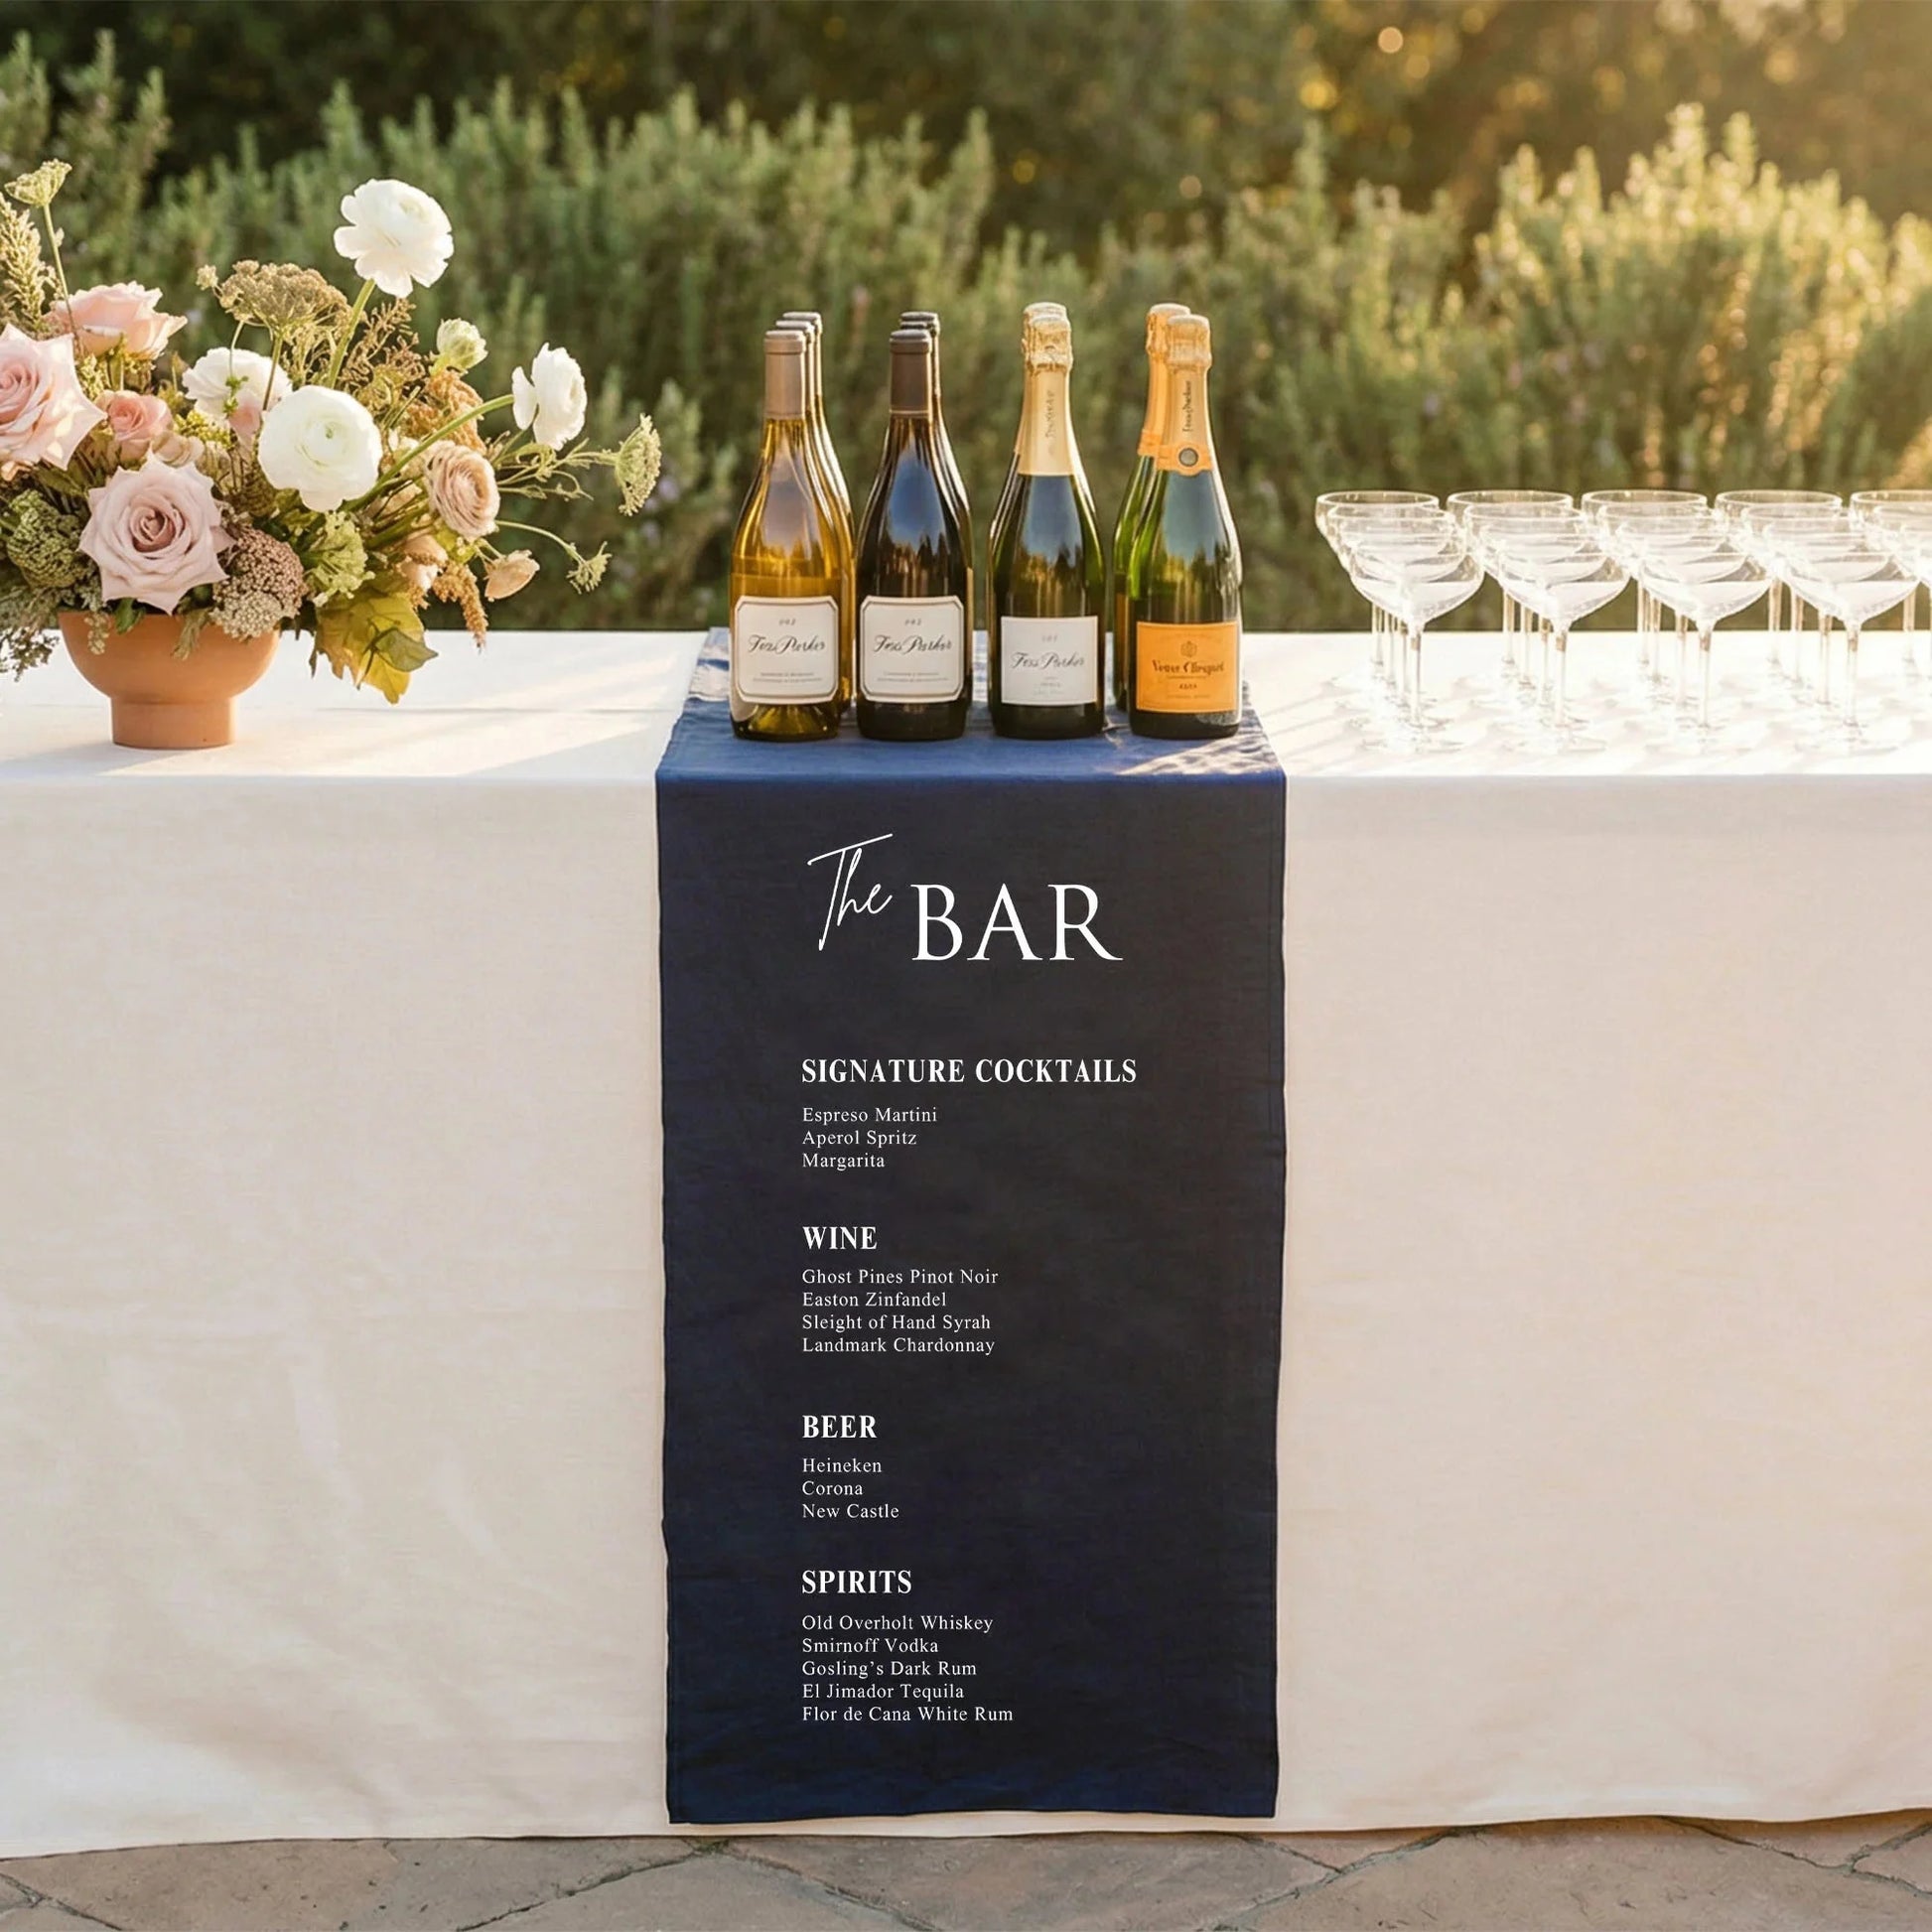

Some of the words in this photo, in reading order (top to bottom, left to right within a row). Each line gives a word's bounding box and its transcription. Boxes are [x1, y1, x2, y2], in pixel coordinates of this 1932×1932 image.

[807, 833, 893, 951] The
[910, 884, 1123, 960] BAR
[801, 1058, 965, 1083] SIGNATURE
[975, 1058, 1137, 1083] COCKTAILS
[802, 1107, 869, 1127] Espreso
[875, 1106, 937, 1123] Martini
[801, 1129, 860, 1149] Aperol
[866, 1129, 917, 1149] Spritz
[802, 1152, 886, 1172] Margarita
[801, 1225, 878, 1250] WINE
[801, 1268, 852, 1285] Ghost
[858, 1268, 903, 1285] Pines
[909, 1268, 954, 1285] Pinot
[959, 1268, 999, 1285] Noir
[802, 1292, 860, 1308] Easton
[865, 1291, 946, 1308] Zinfandel
[802, 1313, 863, 1333] Sleight
[868, 1313, 889, 1330] of
[892, 1313, 936, 1330] Hand
[942, 1313, 991, 1333] Syrah
[802, 1336, 888, 1352] Landmark
[893, 1336, 996, 1356] Chardonnay
[801, 1414, 878, 1439] BEER
[802, 1456, 883, 1473] Heineken
[801, 1479, 864, 1496] Corona
[801, 1503, 840, 1519] New
[846, 1503, 899, 1519] Castle
[801, 1570, 912, 1594] SPIRITS
[801, 1614, 834, 1630] Old
[839, 1614, 913, 1630] Overholt
[920, 1614, 994, 1634] Whiskey
[802, 1637, 881, 1653] Smirnoff
[884, 1637, 939, 1653] Vodka
[801, 1660, 885, 1680] Gosling’s
[891, 1660, 931, 1676] Dark
[938, 1660, 977, 1676] Rum
[802, 1683, 820, 1699] El
[826, 1683, 895, 1699] Jimador
[899, 1683, 965, 1703] Tequila
[802, 1706, 838, 1722] Flor
[843, 1706, 863, 1722] de
[869, 1706, 911, 1722] Cana
[917, 1706, 968, 1722] White
[975, 1706, 1014, 1722] Rum
